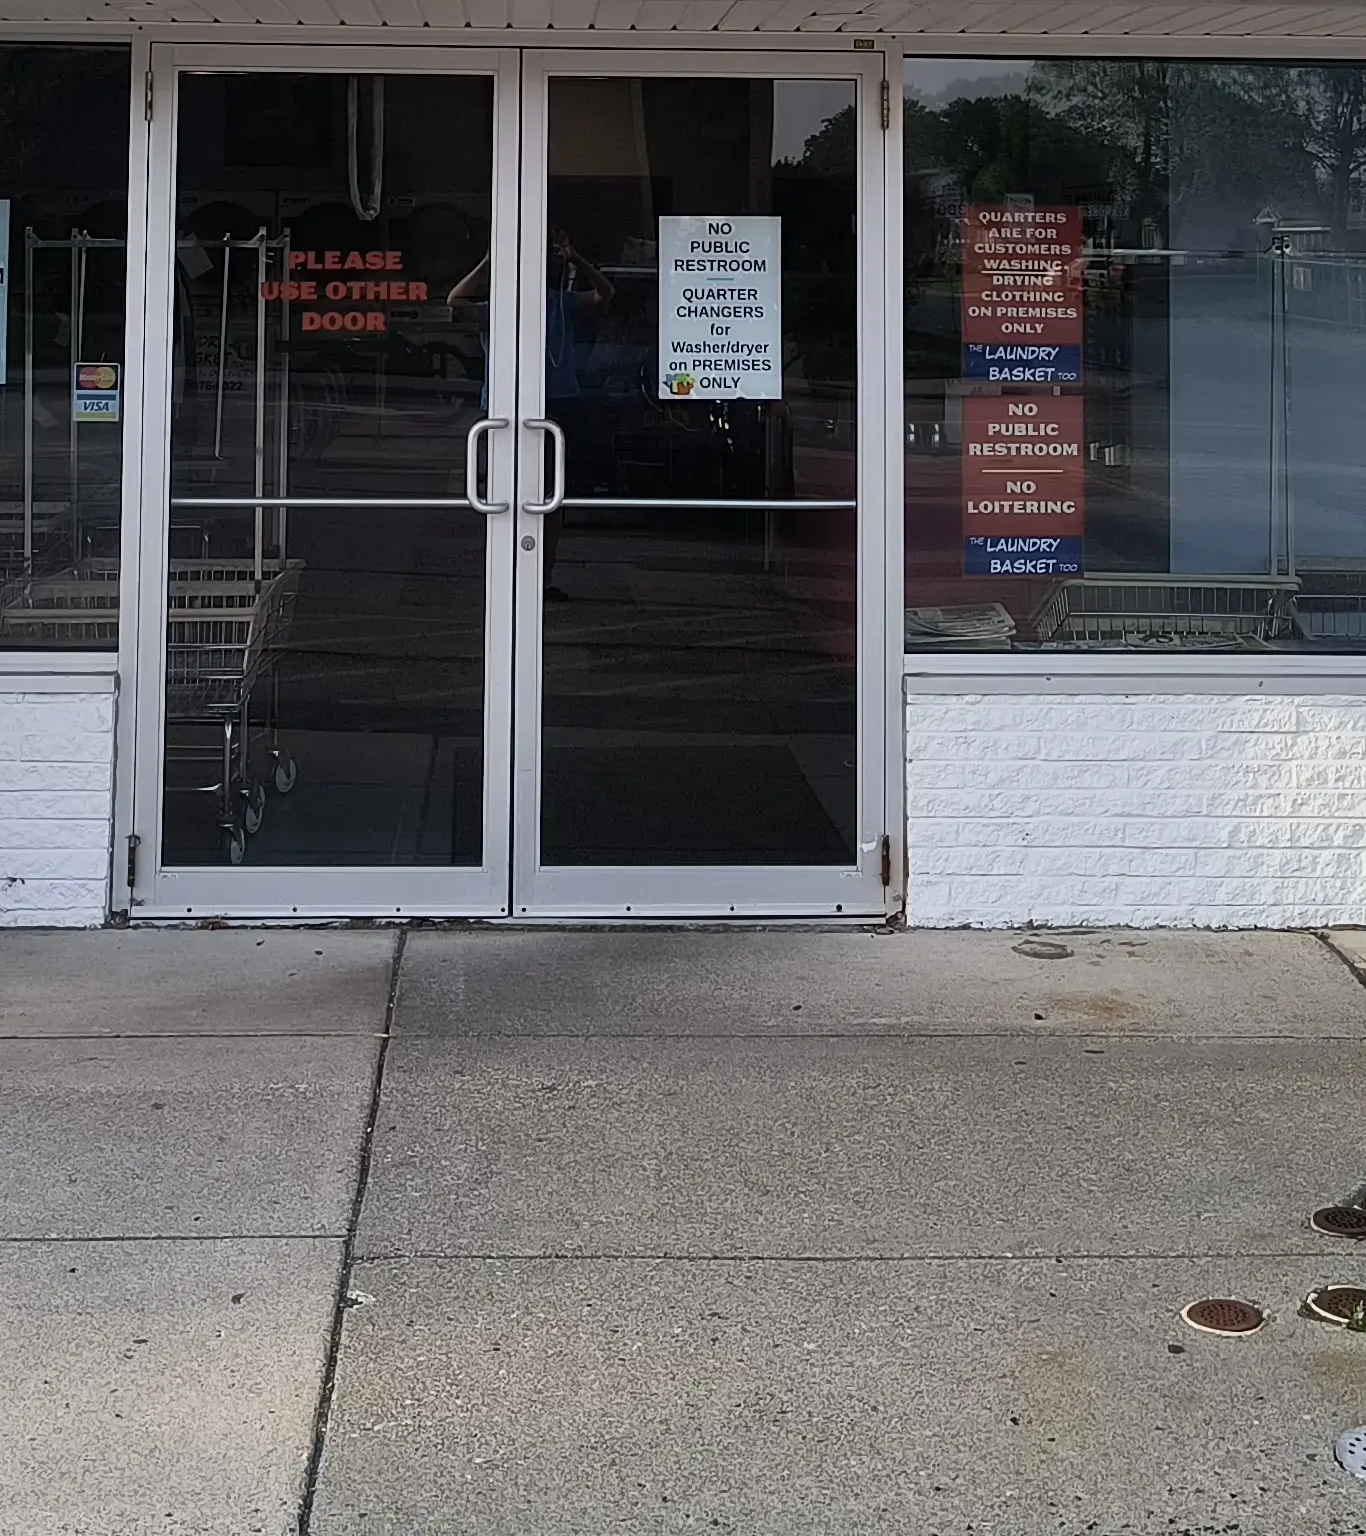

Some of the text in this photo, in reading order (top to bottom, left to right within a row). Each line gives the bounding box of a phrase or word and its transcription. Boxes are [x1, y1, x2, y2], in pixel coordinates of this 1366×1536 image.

[978, 212, 1067, 224] QUARTERS
[708, 222, 732, 235] NO
[989, 228, 1058, 239] ARE FOR
[690, 241, 750, 254] PUBLIC
[974, 243, 1072, 255] CUSTOMERS
[288, 250, 403, 271] PLEASE
[674, 259, 766, 272] RESTROOM
[992, 275, 1054, 286] DRYING
[261, 281, 428, 301] USE OTHER
[682, 288, 758, 303] QUARTER
[981, 291, 1065, 302] CLOTHING
[676, 306, 764, 318] CHANGERS
[968, 306, 1078, 318] ON PREMISES
[302, 311, 387, 332] DOOR
[1001, 322, 1044, 334] ONLY
[710, 323, 731, 336] for
[671, 341, 769, 356] Washer/dryer
[968, 344, 1059, 361] THE LAUNDRY
[669, 359, 772, 372] on PREMISES
[989, 367, 1077, 382] BASKET TOO
[699, 376, 741, 389] ONLY
[83, 401, 110, 412] VISA
[1008, 403, 1038, 416] NO
[988, 423, 1059, 436] PUBLIC
[968, 443, 1078, 456] RESTROOM
[1006, 481, 1037, 494] NO
[967, 500, 1076, 514] LOITERING
[969, 537, 1061, 553] THE LAUNDRY
[990, 559, 1078, 574] BASKET TOO
